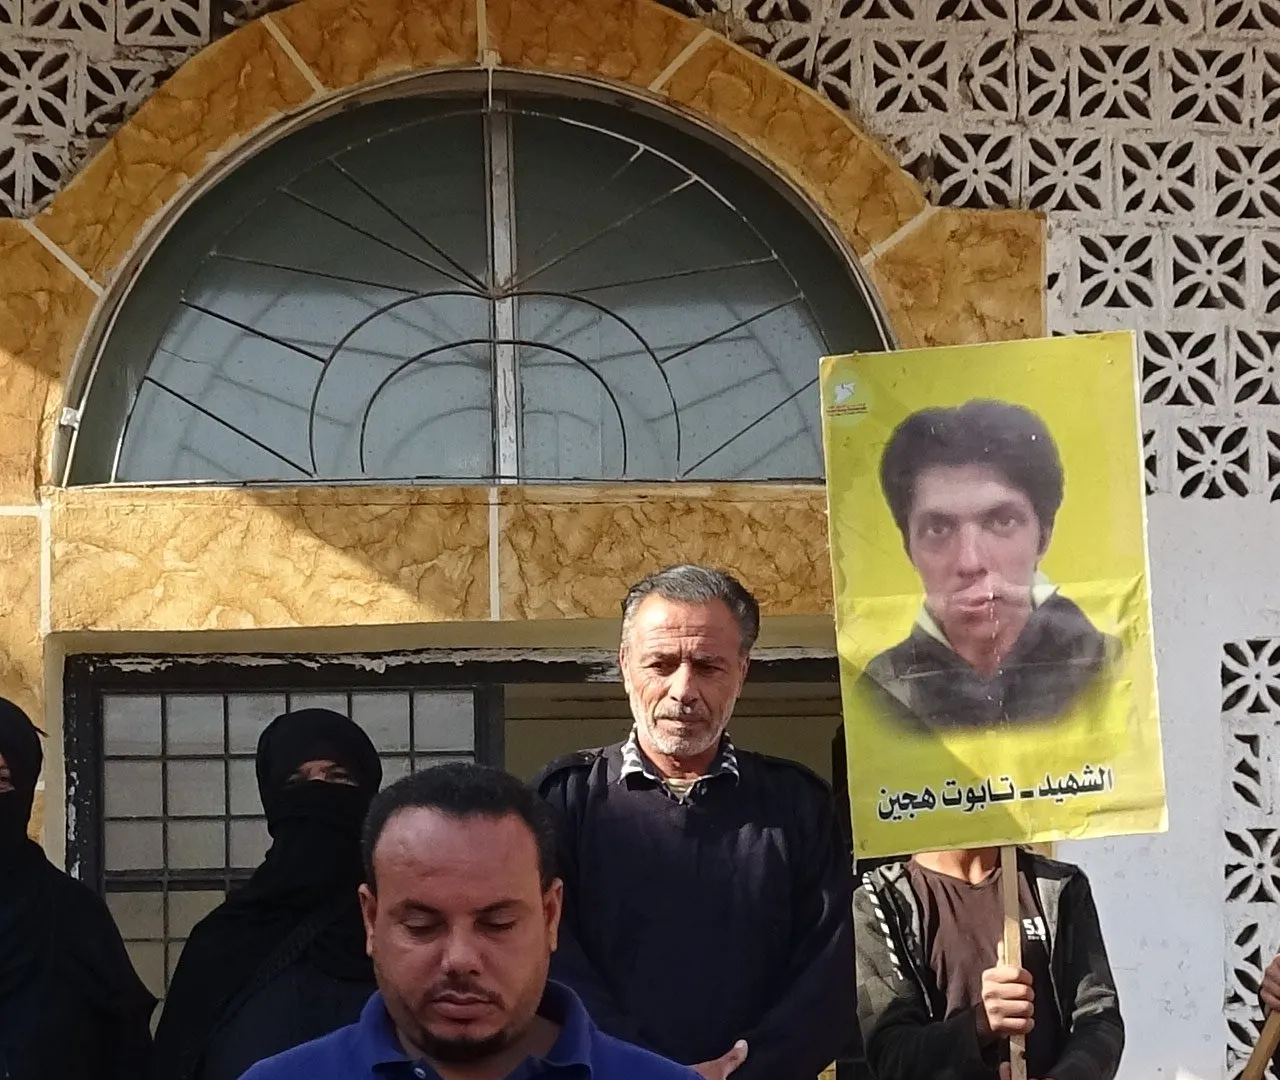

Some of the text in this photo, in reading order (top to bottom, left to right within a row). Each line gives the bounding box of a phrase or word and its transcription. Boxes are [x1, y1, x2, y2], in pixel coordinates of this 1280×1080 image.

[942, 776, 1014, 812] تابوت
[1039, 764, 1113, 802] الشهيد
[878, 787, 936, 821] هجين
